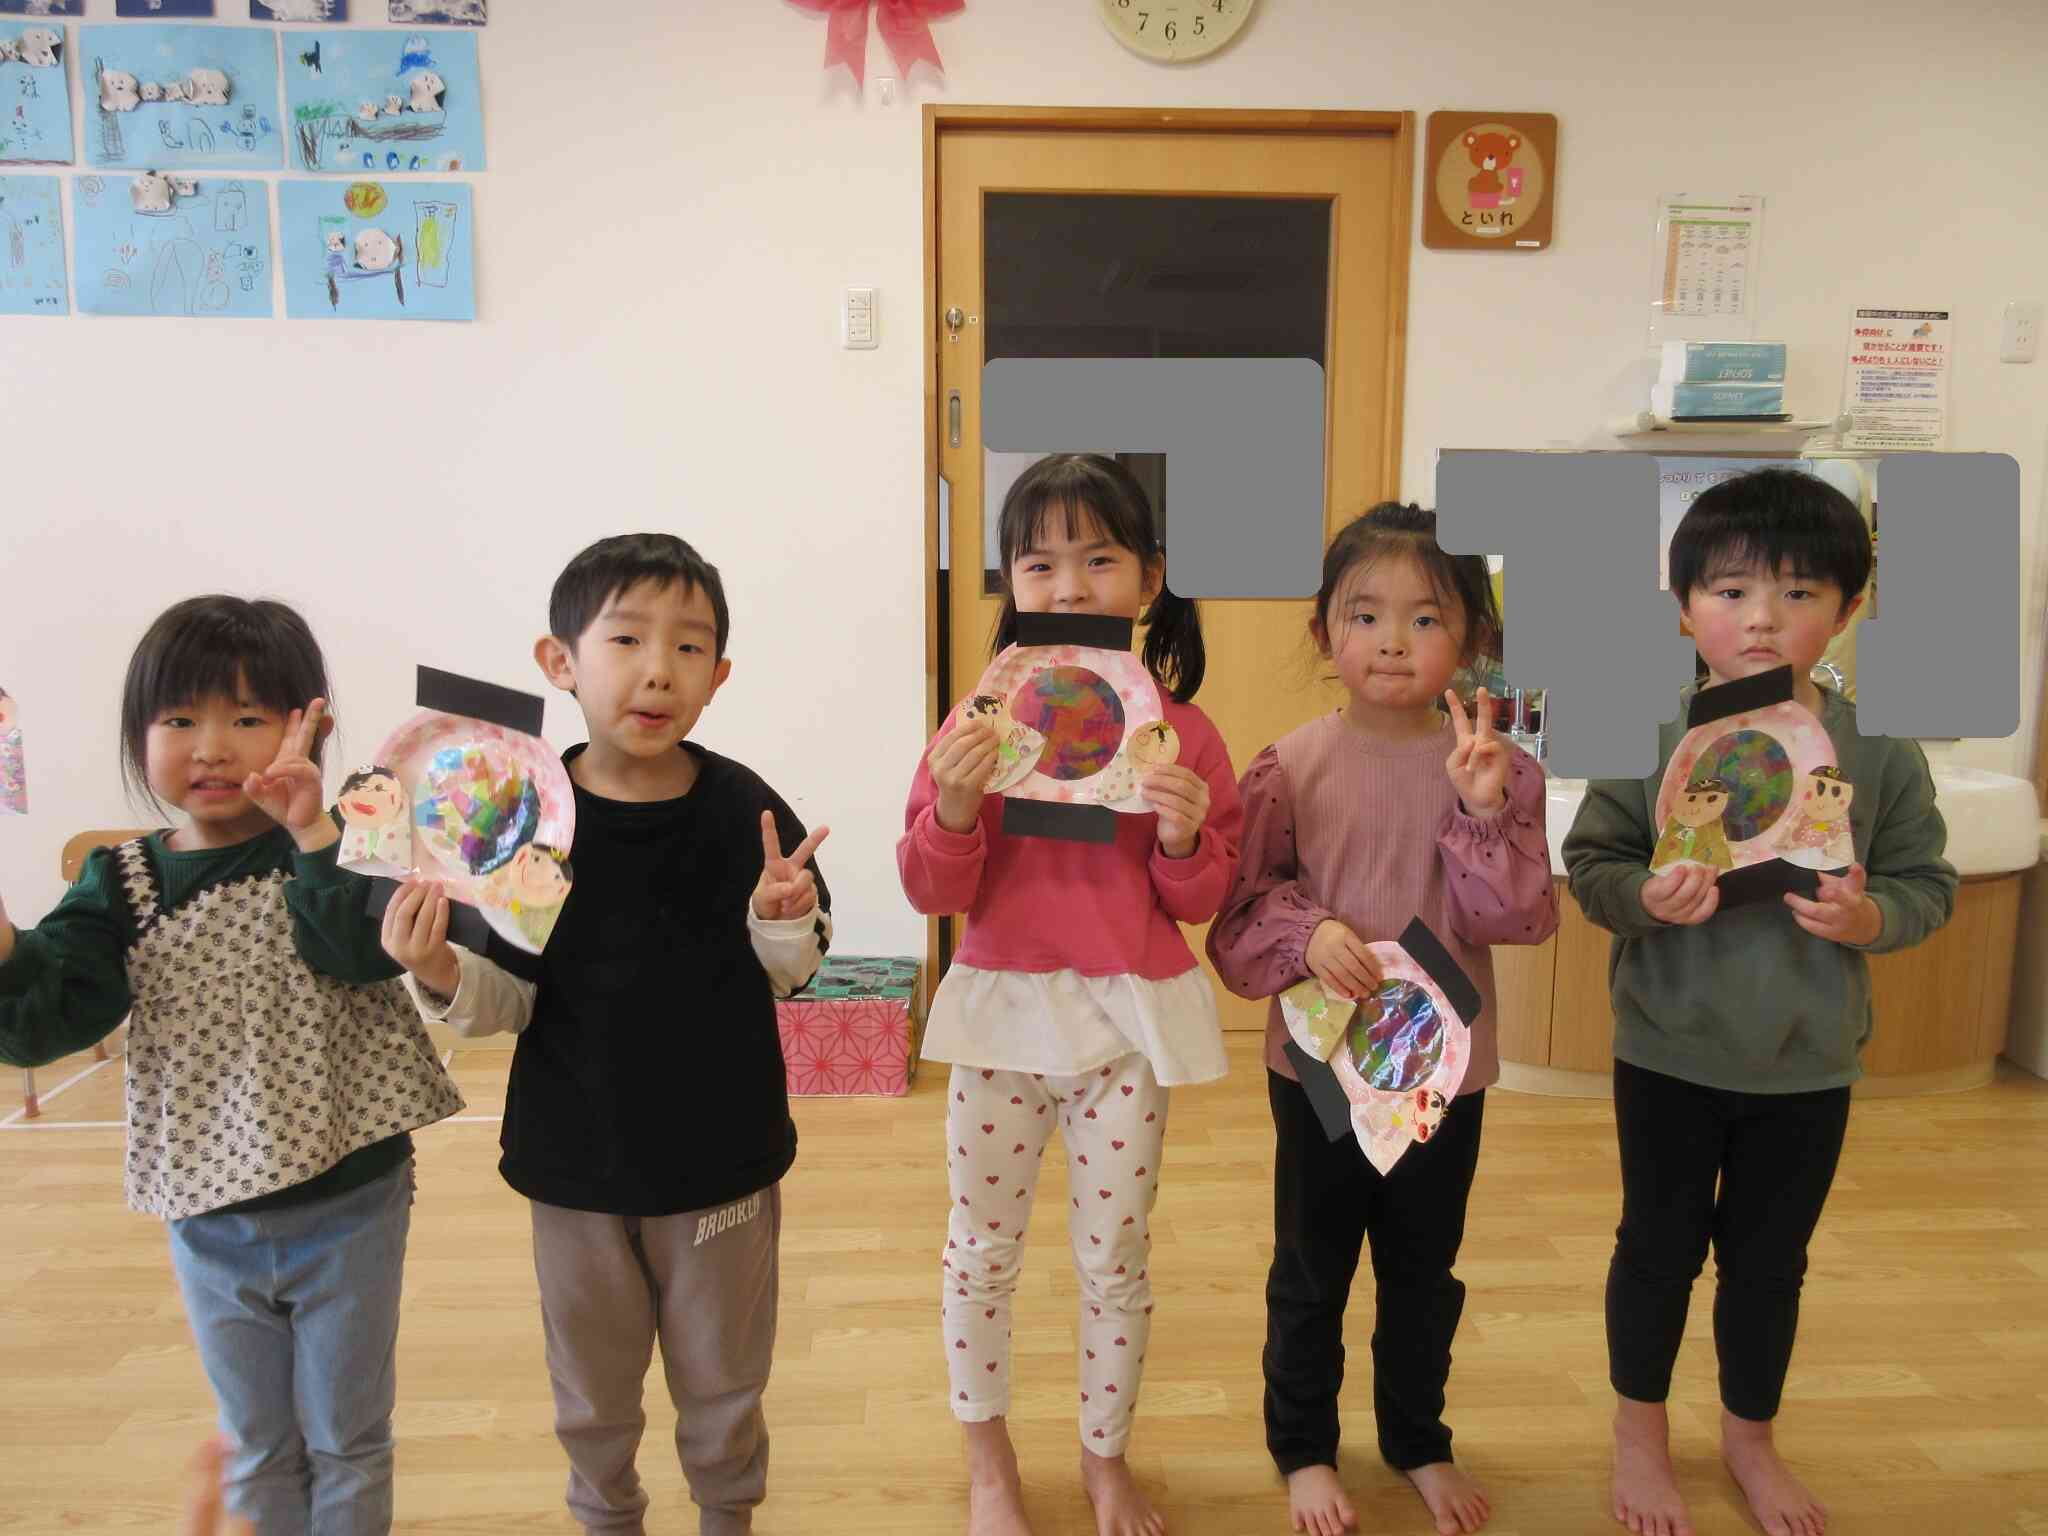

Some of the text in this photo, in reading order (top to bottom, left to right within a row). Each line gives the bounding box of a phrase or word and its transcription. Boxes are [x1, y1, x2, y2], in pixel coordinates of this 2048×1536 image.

[1212, 0, 1223, 13] 4
[1138, 12, 1149, 31] 7
[1164, 21, 1177, 41] 6
[1193, 16, 1205, 35] 5
[1461, 210, 1514, 226] といれ
